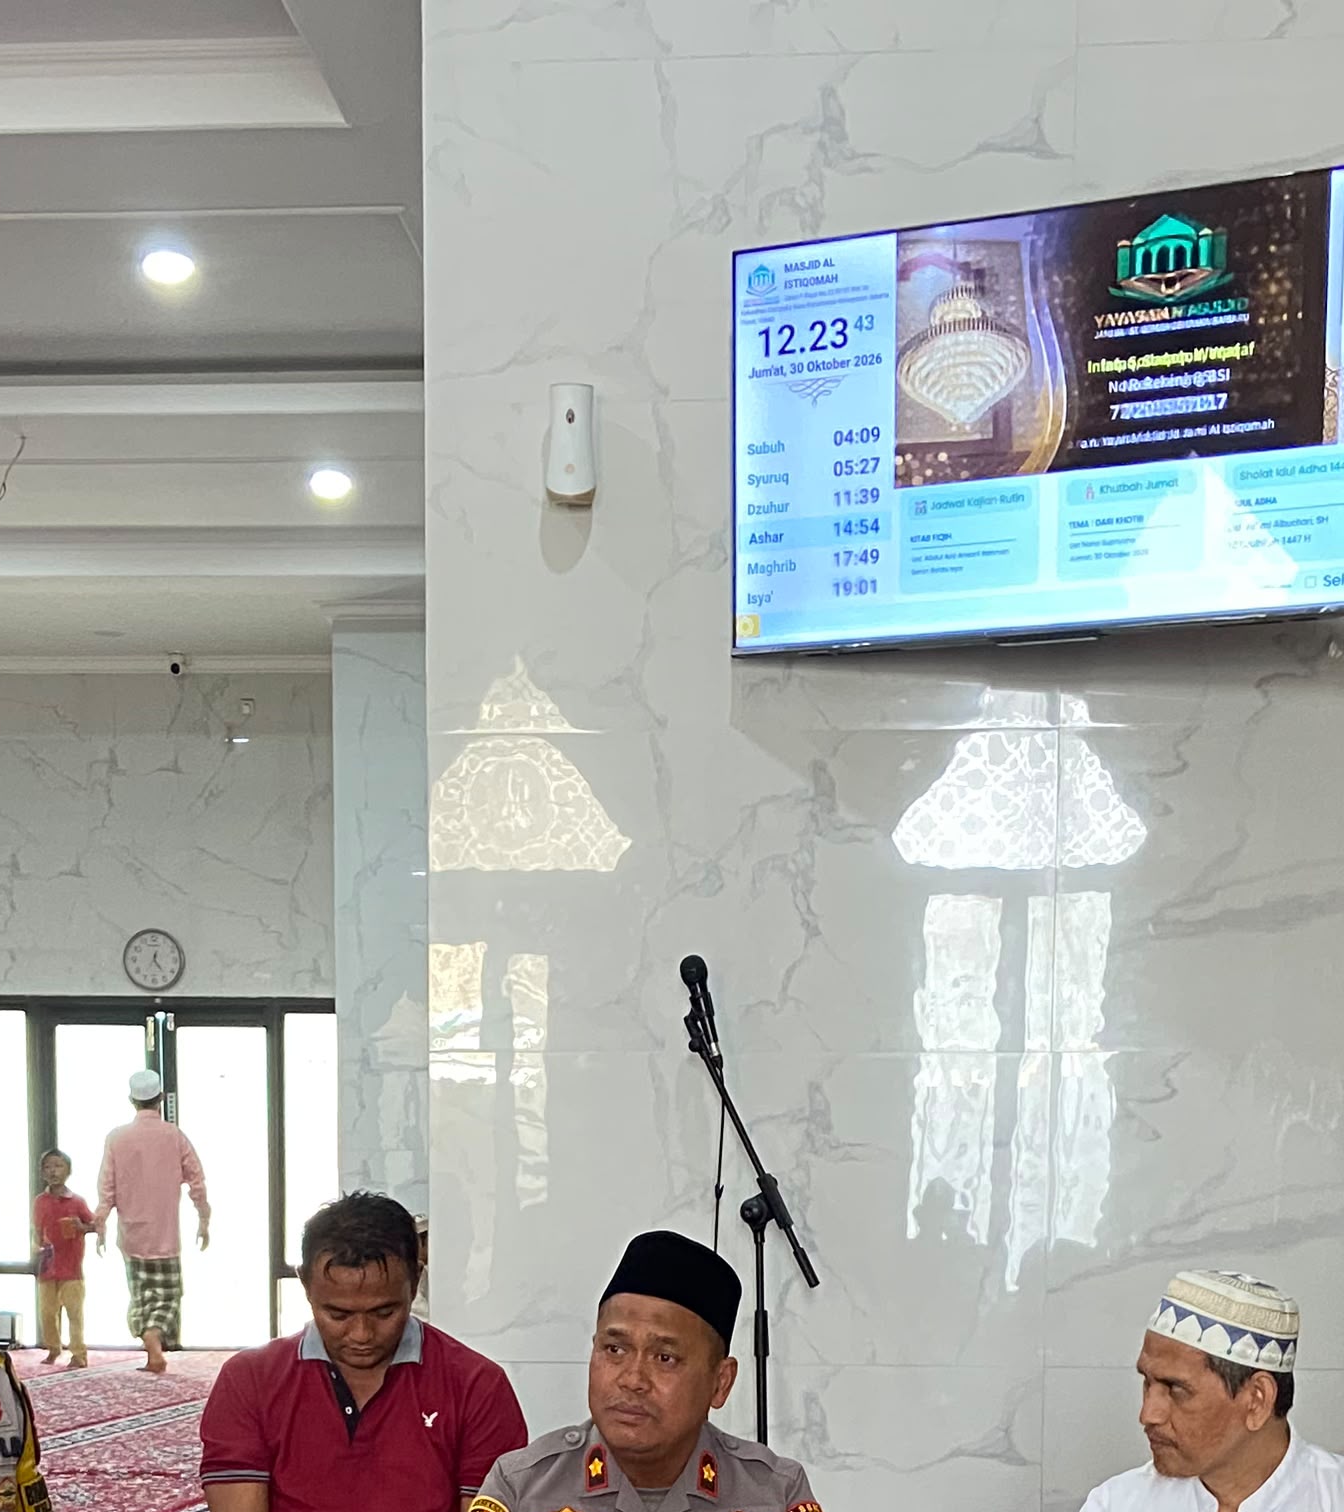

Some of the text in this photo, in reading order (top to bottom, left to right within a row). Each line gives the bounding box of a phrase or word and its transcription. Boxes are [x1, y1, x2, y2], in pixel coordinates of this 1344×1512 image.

[784, 258, 835, 273] MASJID AL
[784, 274, 839, 289] ISTIQOMAH
[758, 314, 875, 358] 12.23 43
[789, 362, 805, 375] 30
[806, 357, 852, 373] Oktober
[853, 352, 883, 368] 2026
[747, 426, 881, 455] Subuh 04:09
[747, 457, 881, 488] Syuruq 05:27
[1239, 468, 1274, 481] Sholat
[1298, 463, 1328, 475] Adha
[747, 487, 881, 515] Dzuhur 11:39
[929, 492, 1025, 511] Jadwal Kajian Rutin
[748, 518, 881, 545] Ashar 14:54
[747, 548, 880, 577] Maghrib 17:49
[747, 579, 878, 607] Isya' 19:01
